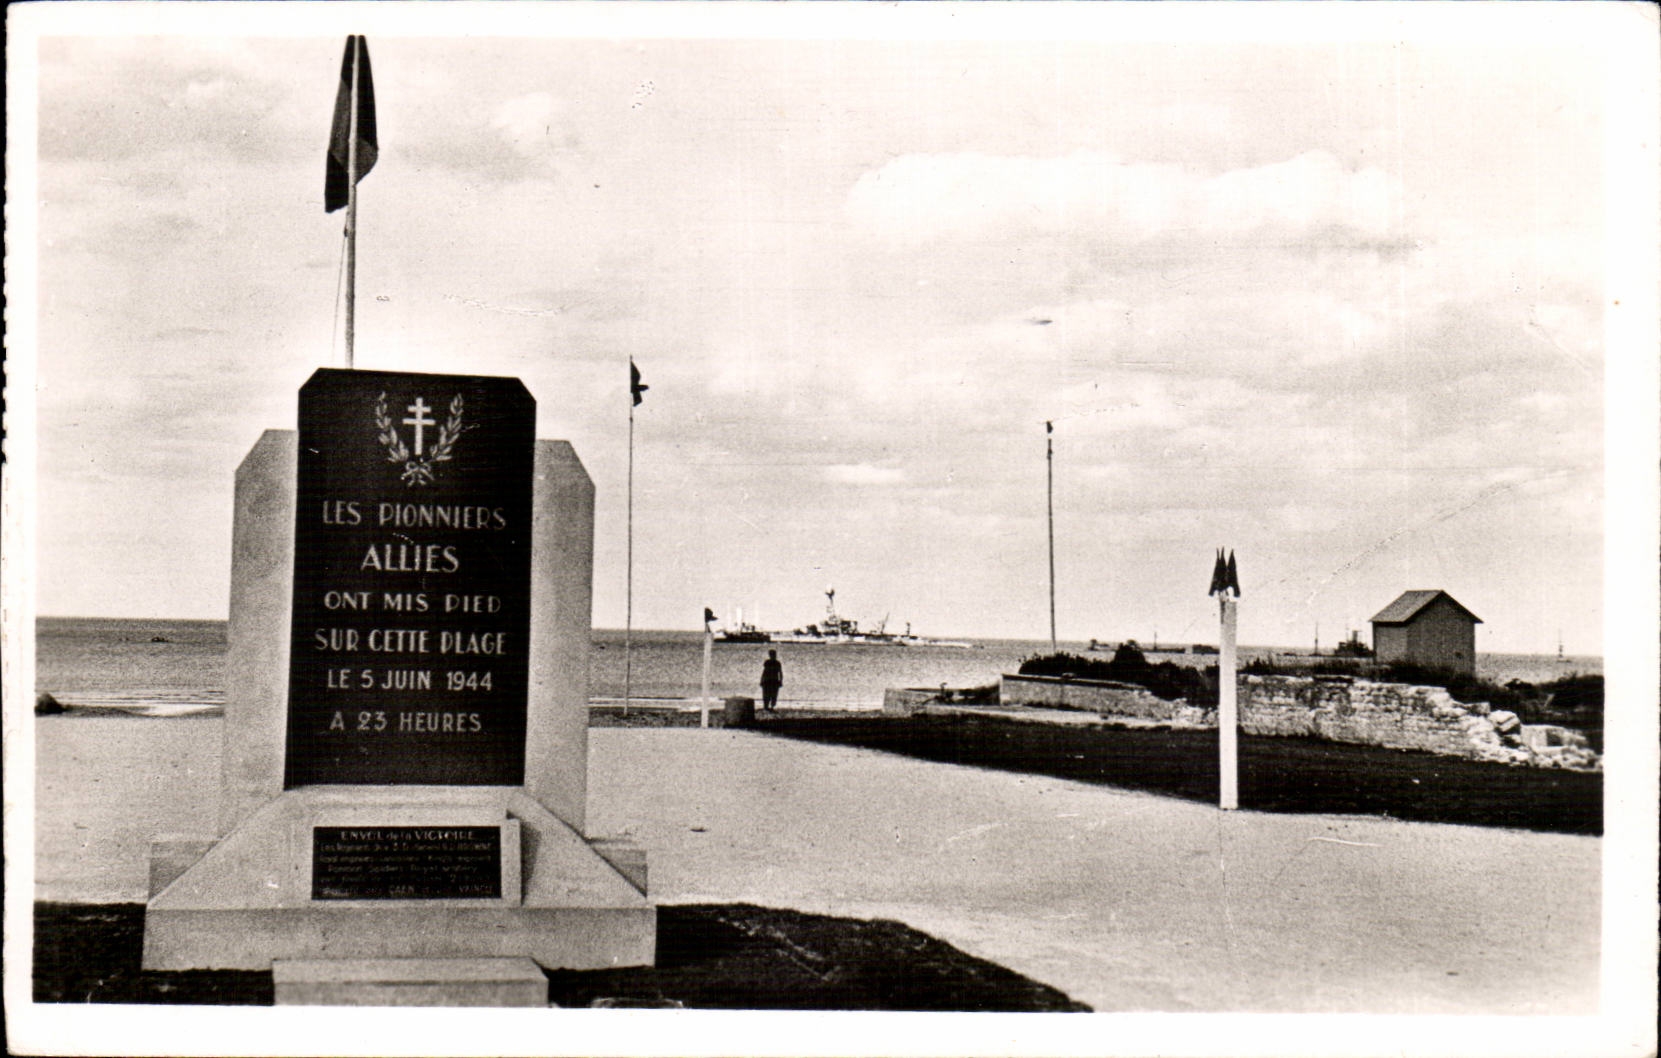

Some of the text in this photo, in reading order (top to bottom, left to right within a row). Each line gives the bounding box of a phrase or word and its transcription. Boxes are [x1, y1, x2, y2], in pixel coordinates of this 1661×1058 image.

[323, 501, 507, 530] LES PIONNIERS
[361, 543, 460, 573] ALLIES
[324, 591, 502, 614] ONT MIS PIED
[314, 628, 507, 656] SUR CETTE PLAGE
[327, 668, 492, 692] LE 5 JUIN 1944
[329, 711, 482, 733] A 23 HEURES
[414, 830, 474, 840] VICTOIRE
